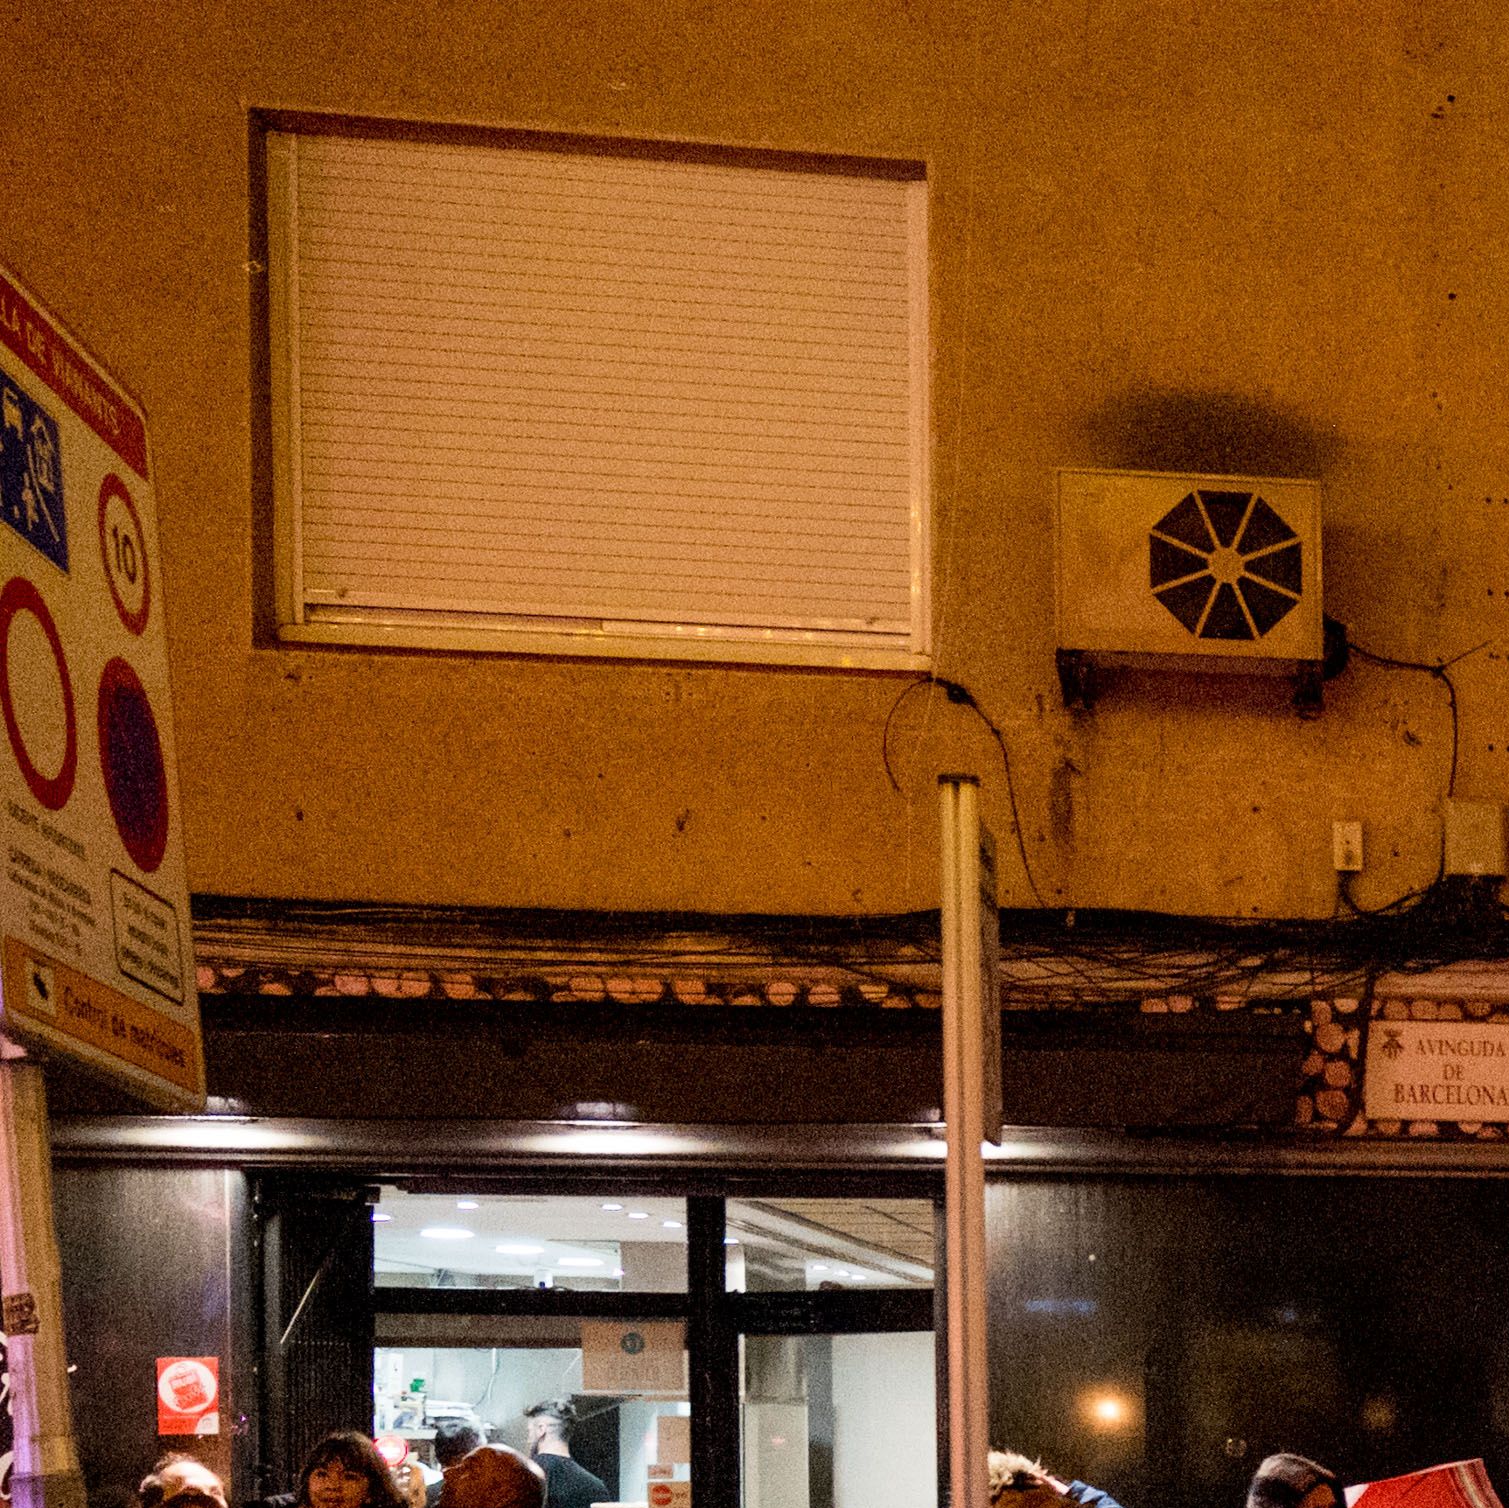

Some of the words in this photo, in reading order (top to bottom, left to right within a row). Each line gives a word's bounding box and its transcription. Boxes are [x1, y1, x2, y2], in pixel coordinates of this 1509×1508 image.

[113, 525, 137, 585] 10
[1415, 1039, 1506, 1058] AVINGUDA
[1443, 1064, 1465, 1081] DE
[1394, 1083, 1509, 1107] BARCELONA
